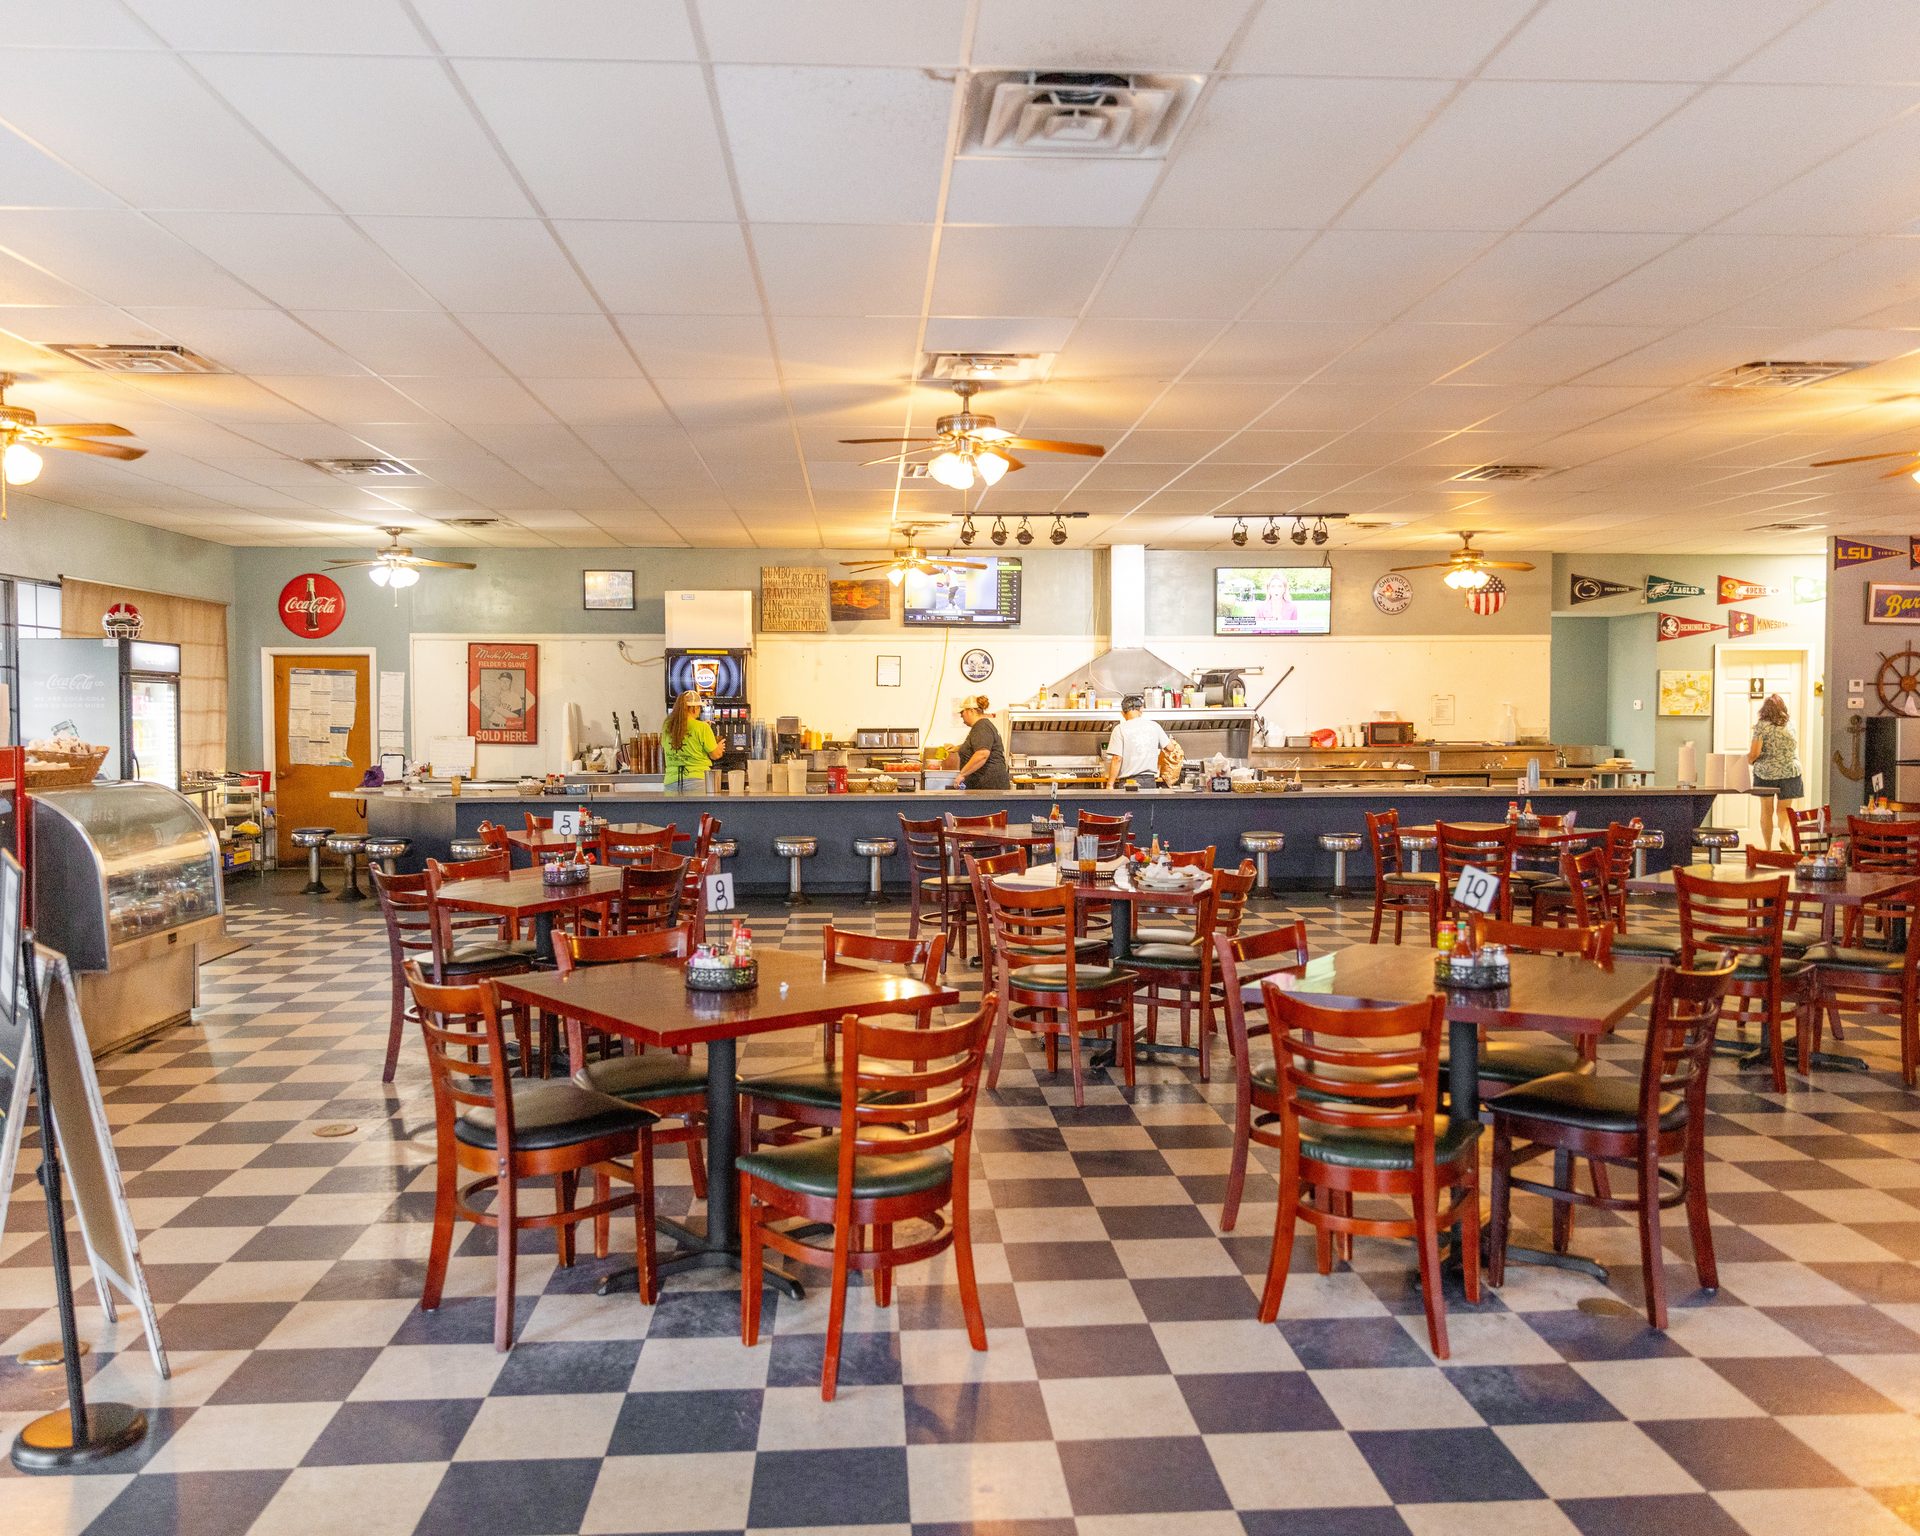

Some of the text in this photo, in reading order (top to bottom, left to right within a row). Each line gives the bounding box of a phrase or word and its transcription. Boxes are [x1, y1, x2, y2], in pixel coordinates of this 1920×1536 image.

[1837, 547, 1873, 560] LSU
[763, 566, 790, 579] GUMBO
[1379, 577, 1411, 592] CHEVROLET
[1673, 585, 1700, 595] EAGLES
[763, 588, 802, 600] CRAWFISH
[1745, 587, 1767, 596] 49ERS
[284, 596, 337, 614] Coca-Cola
[763, 600, 782, 612] KING
[783, 607, 827, 620] OYSTERS
[783, 620, 812, 631] SHRIMP
[1680, 622, 1711, 632] SEMINOLES
[478, 660, 507, 668] FIELDER'S
[475, 730, 528, 742] SOLD HERE
[563, 814, 571, 828] 5
[715, 880, 725, 900] 9
[1466, 874, 1488, 900] 10
